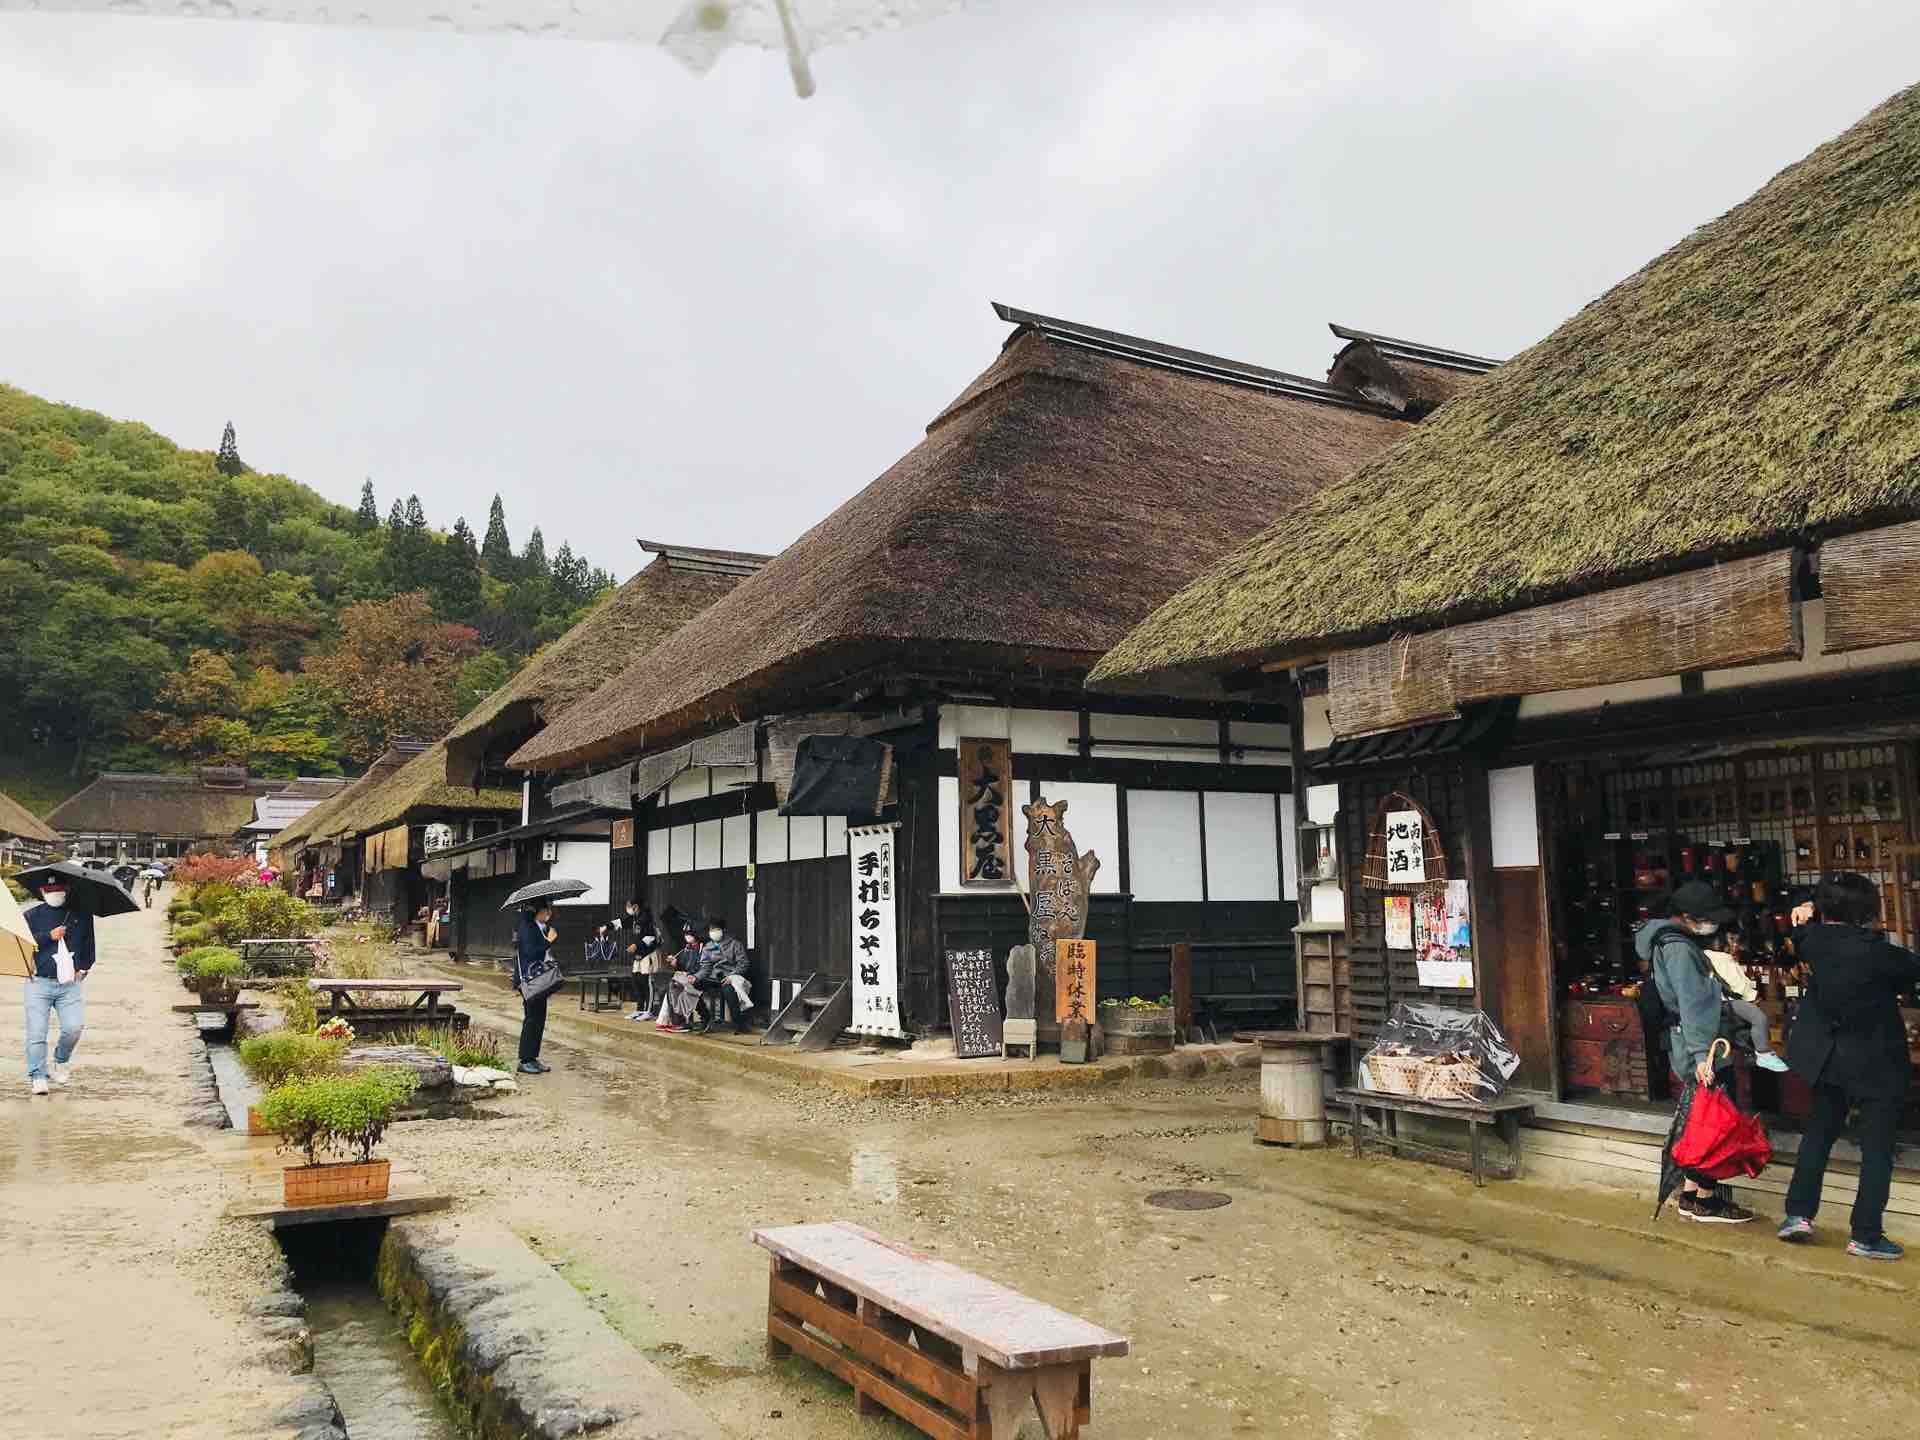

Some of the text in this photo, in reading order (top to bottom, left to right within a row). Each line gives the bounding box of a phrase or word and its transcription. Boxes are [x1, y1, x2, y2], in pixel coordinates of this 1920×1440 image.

[1033, 815, 1056, 920] 大黒屋
[1388, 822, 1409, 872] 地酒
[858, 851, 880, 986] 手打ちそば
